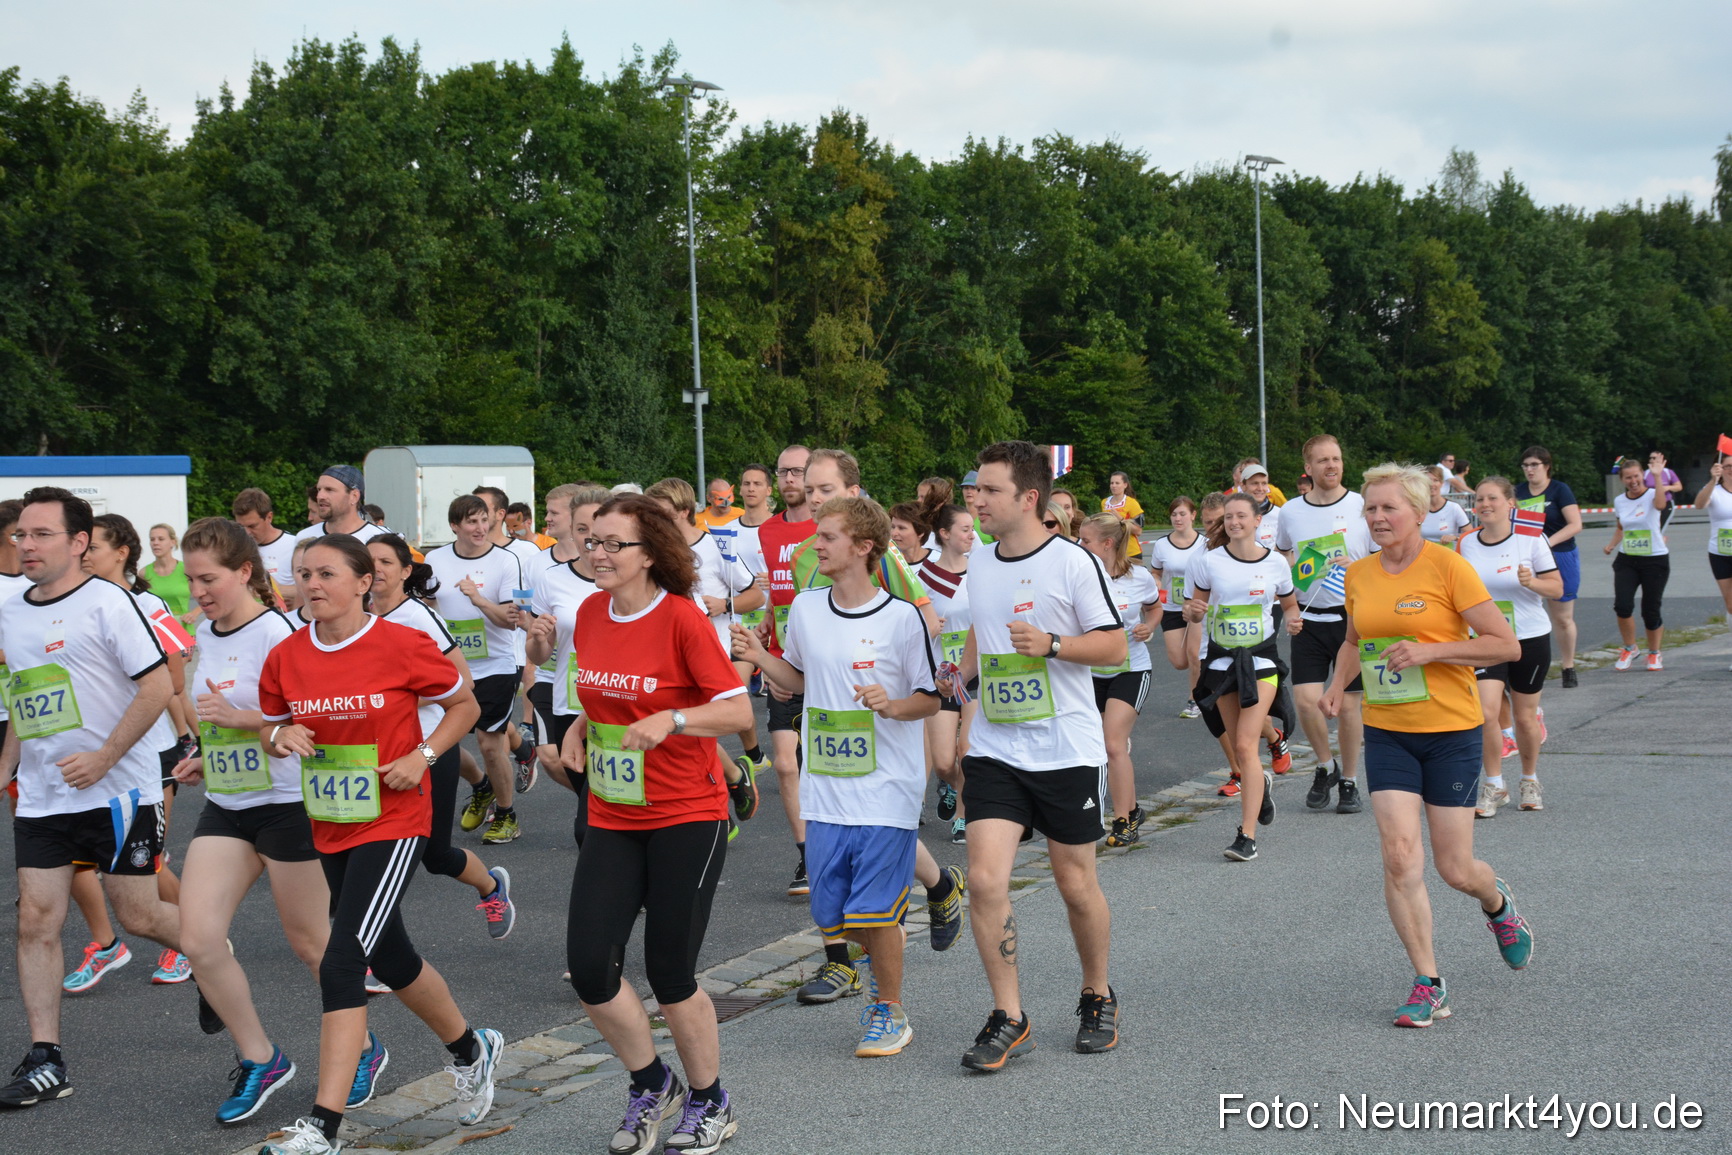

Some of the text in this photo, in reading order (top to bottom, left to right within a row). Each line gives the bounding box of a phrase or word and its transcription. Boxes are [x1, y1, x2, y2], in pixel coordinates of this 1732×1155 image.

[1626, 539, 1649, 548] 1544
[1219, 621, 1258, 636] 1535
[1374, 665, 1402, 685] 73
[987, 679, 1043, 704] 1533
[15, 689, 65, 720] 1527
[814, 735, 868, 758] 1543
[208, 748, 260, 773] 1518
[590, 749, 636, 783] 1413
[309, 775, 371, 800] 1412
